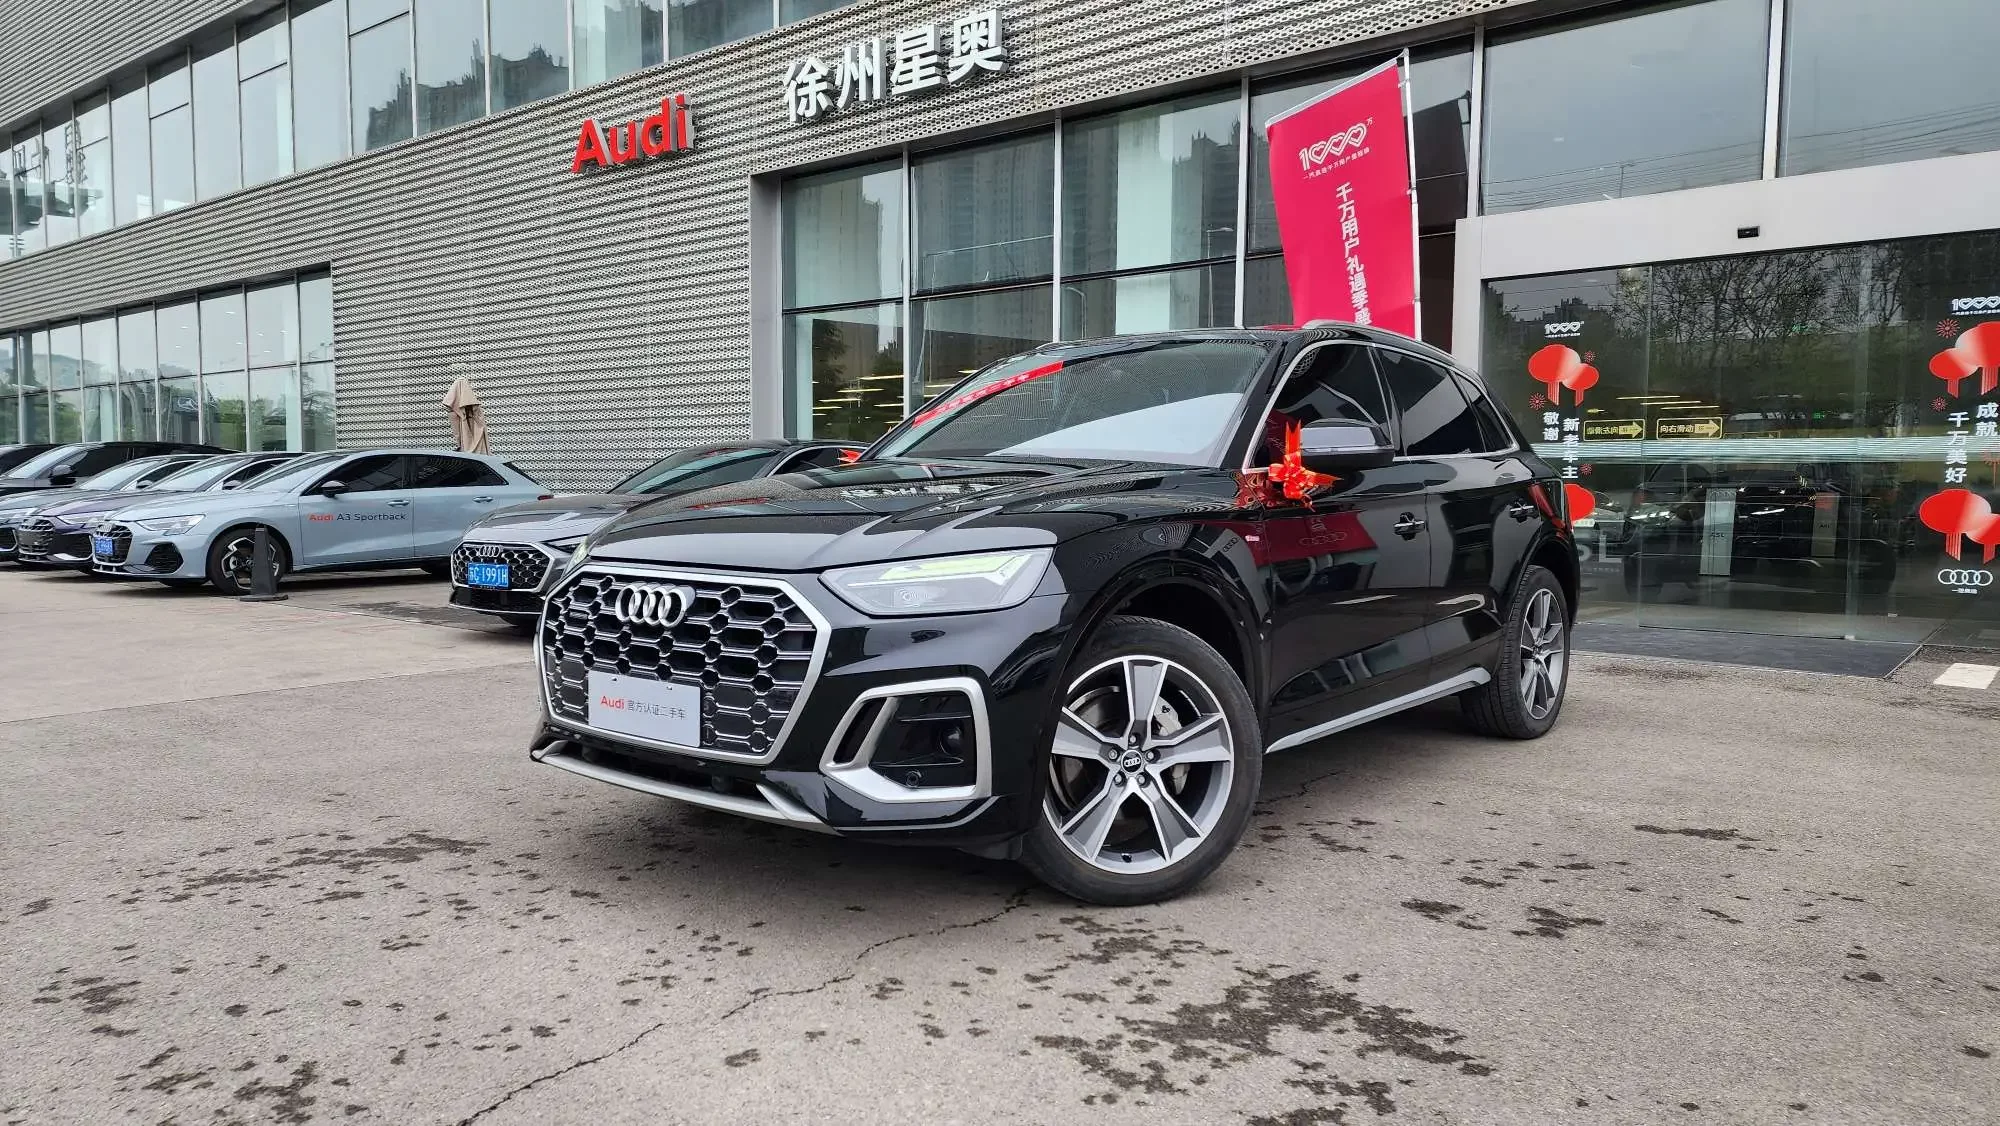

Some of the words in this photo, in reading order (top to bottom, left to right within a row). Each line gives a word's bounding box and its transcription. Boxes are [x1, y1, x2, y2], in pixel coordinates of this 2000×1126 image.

[783, 9, 1005, 123] 徐州星奥
[571, 92, 694, 174] Audi
[1542, 411, 1560, 441] 敬谢
[1660, 424, 1694, 433] 向右滑动
[1975, 402, 1999, 436] 成就
[1561, 417, 1580, 479] 新老车主
[1944, 411, 1970, 483] 千万美好
[308, 513, 334, 521] Audi
[336, 513, 351, 521] A3
[354, 513, 406, 522] Sportback
[600, 695, 625, 710] Audi
[627, 699, 687, 721] 官方认证二手车
